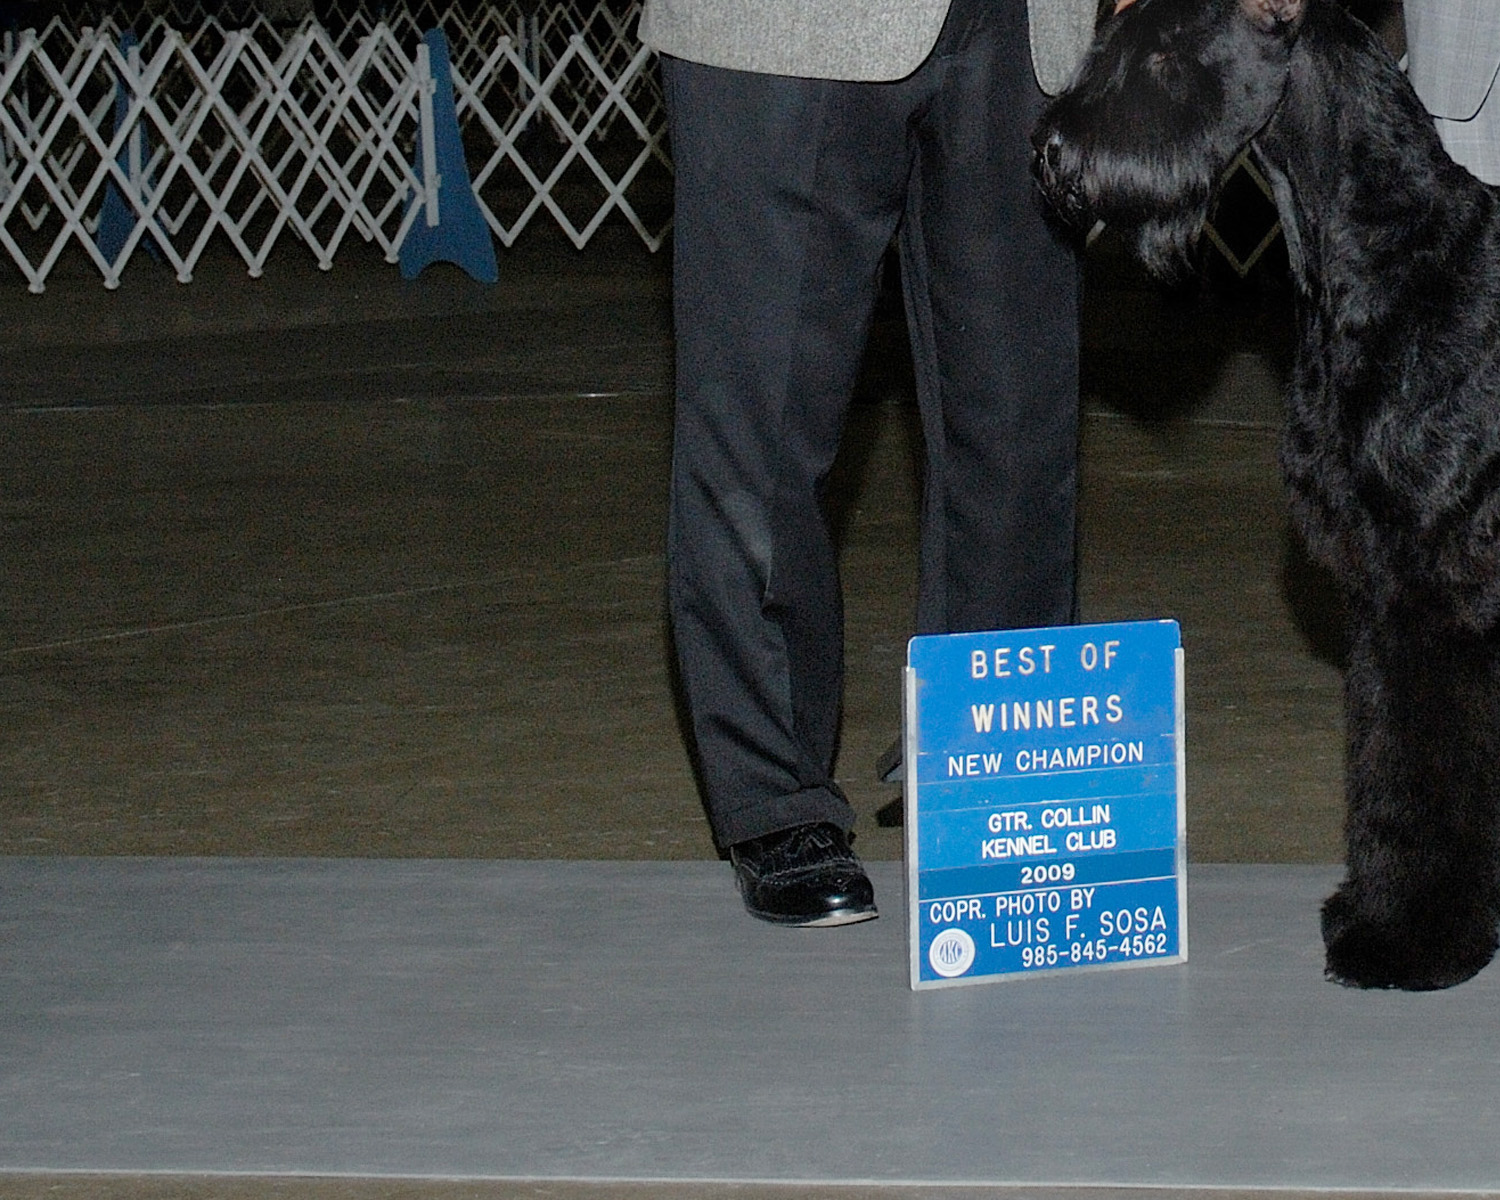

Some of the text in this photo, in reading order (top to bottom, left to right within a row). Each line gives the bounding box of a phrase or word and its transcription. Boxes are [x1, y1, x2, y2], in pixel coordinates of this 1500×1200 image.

[971, 640, 1121, 680] BEST OF
[970, 694, 1124, 734] WINNERS
[948, 740, 1144, 777] NEW CHAMPION
[987, 803, 1111, 834] GTR. COLLIN
[981, 828, 1117, 860] KENNEL CLUB
[1020, 862, 1076, 885] 2009
[929, 887, 1096, 924] COPR. PHOTO BY
[990, 905, 1167, 948] LUIS F. SOSA
[1021, 934, 1167, 968] 985-845-4562
